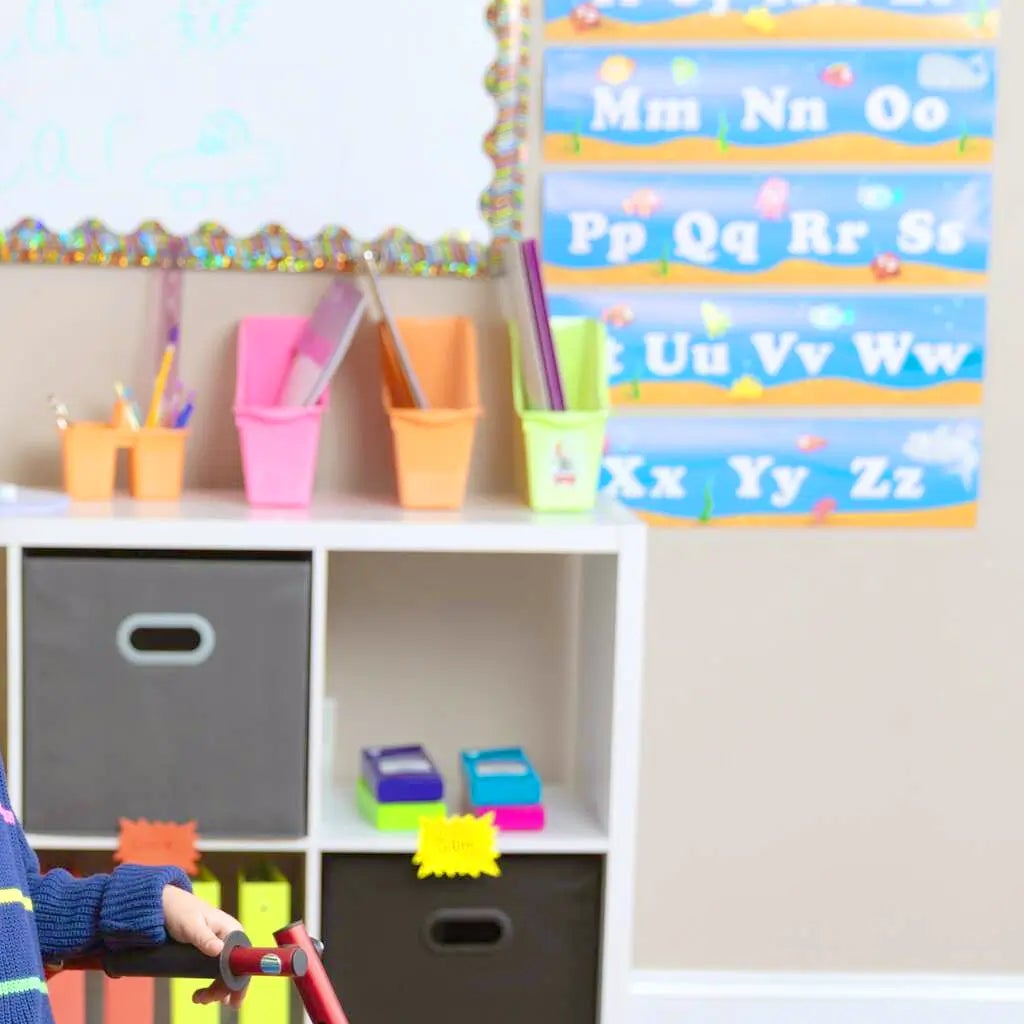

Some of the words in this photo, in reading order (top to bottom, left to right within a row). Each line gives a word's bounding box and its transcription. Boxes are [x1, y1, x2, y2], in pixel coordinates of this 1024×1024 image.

[589, 85, 701, 131] Mm
[740, 85, 829, 131] Nn
[864, 85, 950, 131] Oo
[568, 209, 647, 263] Pp
[672, 209, 760, 265] Qq
[787, 208, 869, 254] Rr
[896, 208, 966, 254] Ss
[644, 331, 730, 376] Uu
[749, 331, 834, 375] Vv
[852, 331, 972, 375] Ww
[600, 455, 687, 499] Xx
[728, 455, 809, 507] Yy
[849, 455, 926, 499] Zz
